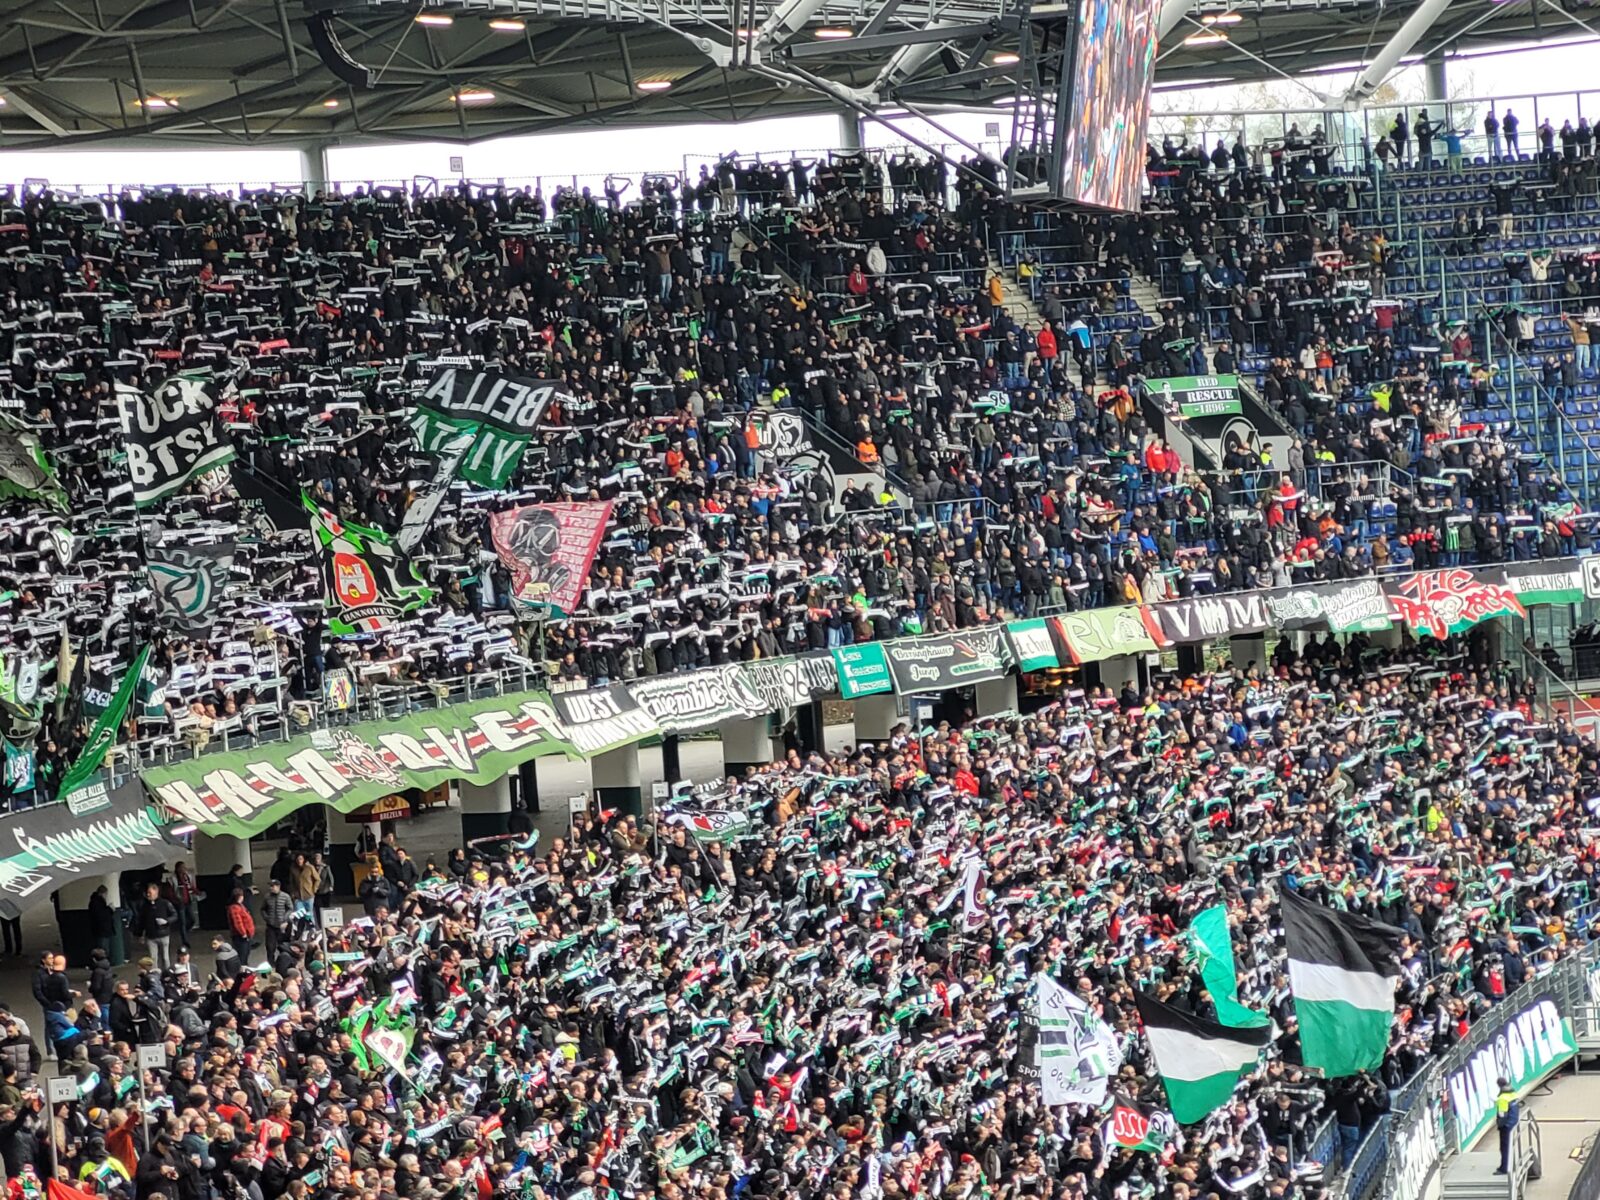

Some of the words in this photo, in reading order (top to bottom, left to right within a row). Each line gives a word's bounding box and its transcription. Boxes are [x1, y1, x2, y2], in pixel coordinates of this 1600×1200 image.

[1197, 378, 1218, 387] RED
[989, 391, 1006, 407] 96
[1187, 389, 1234, 402] RESCUE
[114, 379, 214, 435] FUCK
[1518, 576, 1548, 591] BELLA
[1547, 573, 1575, 589] VISTA
[343, 606, 396, 622] HANNOVER
[564, 690, 622, 723] WEST
[380, 810, 403, 819] BREZELN
